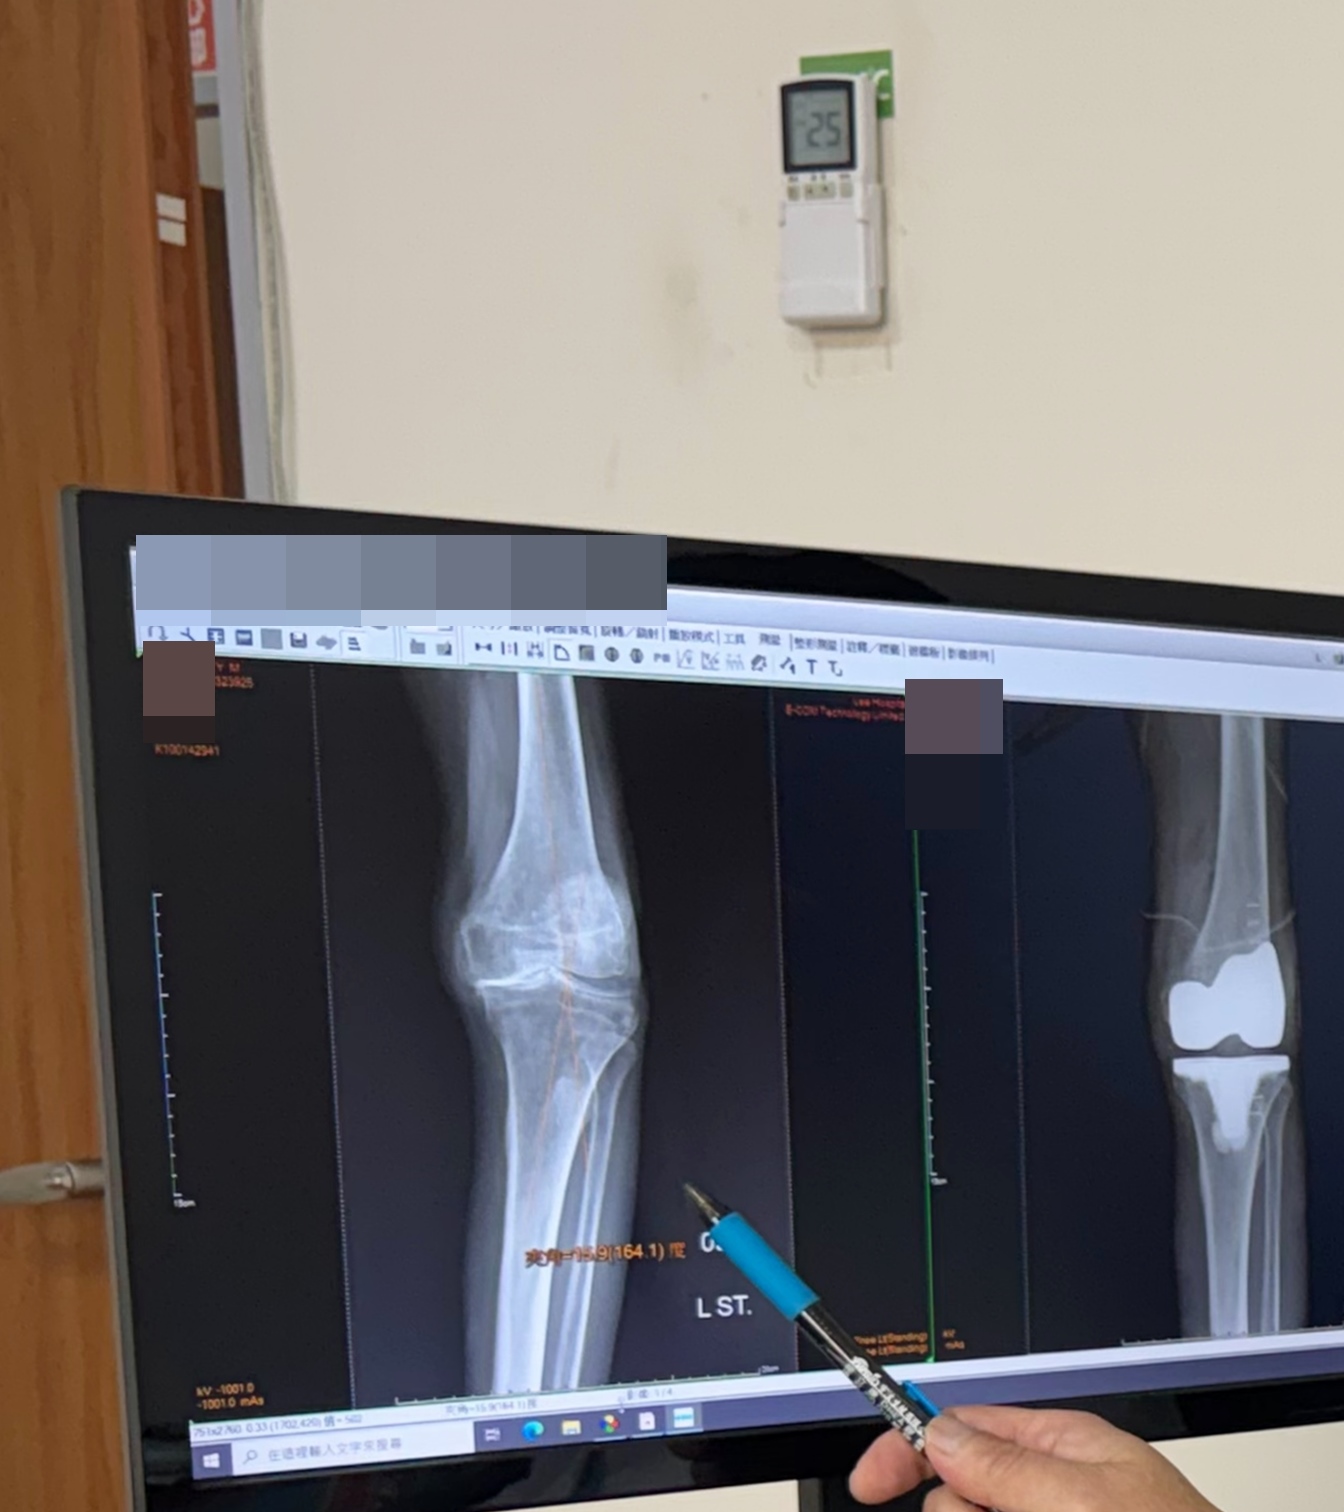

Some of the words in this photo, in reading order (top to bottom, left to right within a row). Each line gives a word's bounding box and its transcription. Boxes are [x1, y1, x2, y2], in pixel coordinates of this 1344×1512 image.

[806, 112, 842, 147] 25
[697, 1298, 713, 1319] L
[716, 1295, 753, 1317] ST.
[268, 1437, 403, 1463] 在這裡輸入文字來搜尋
